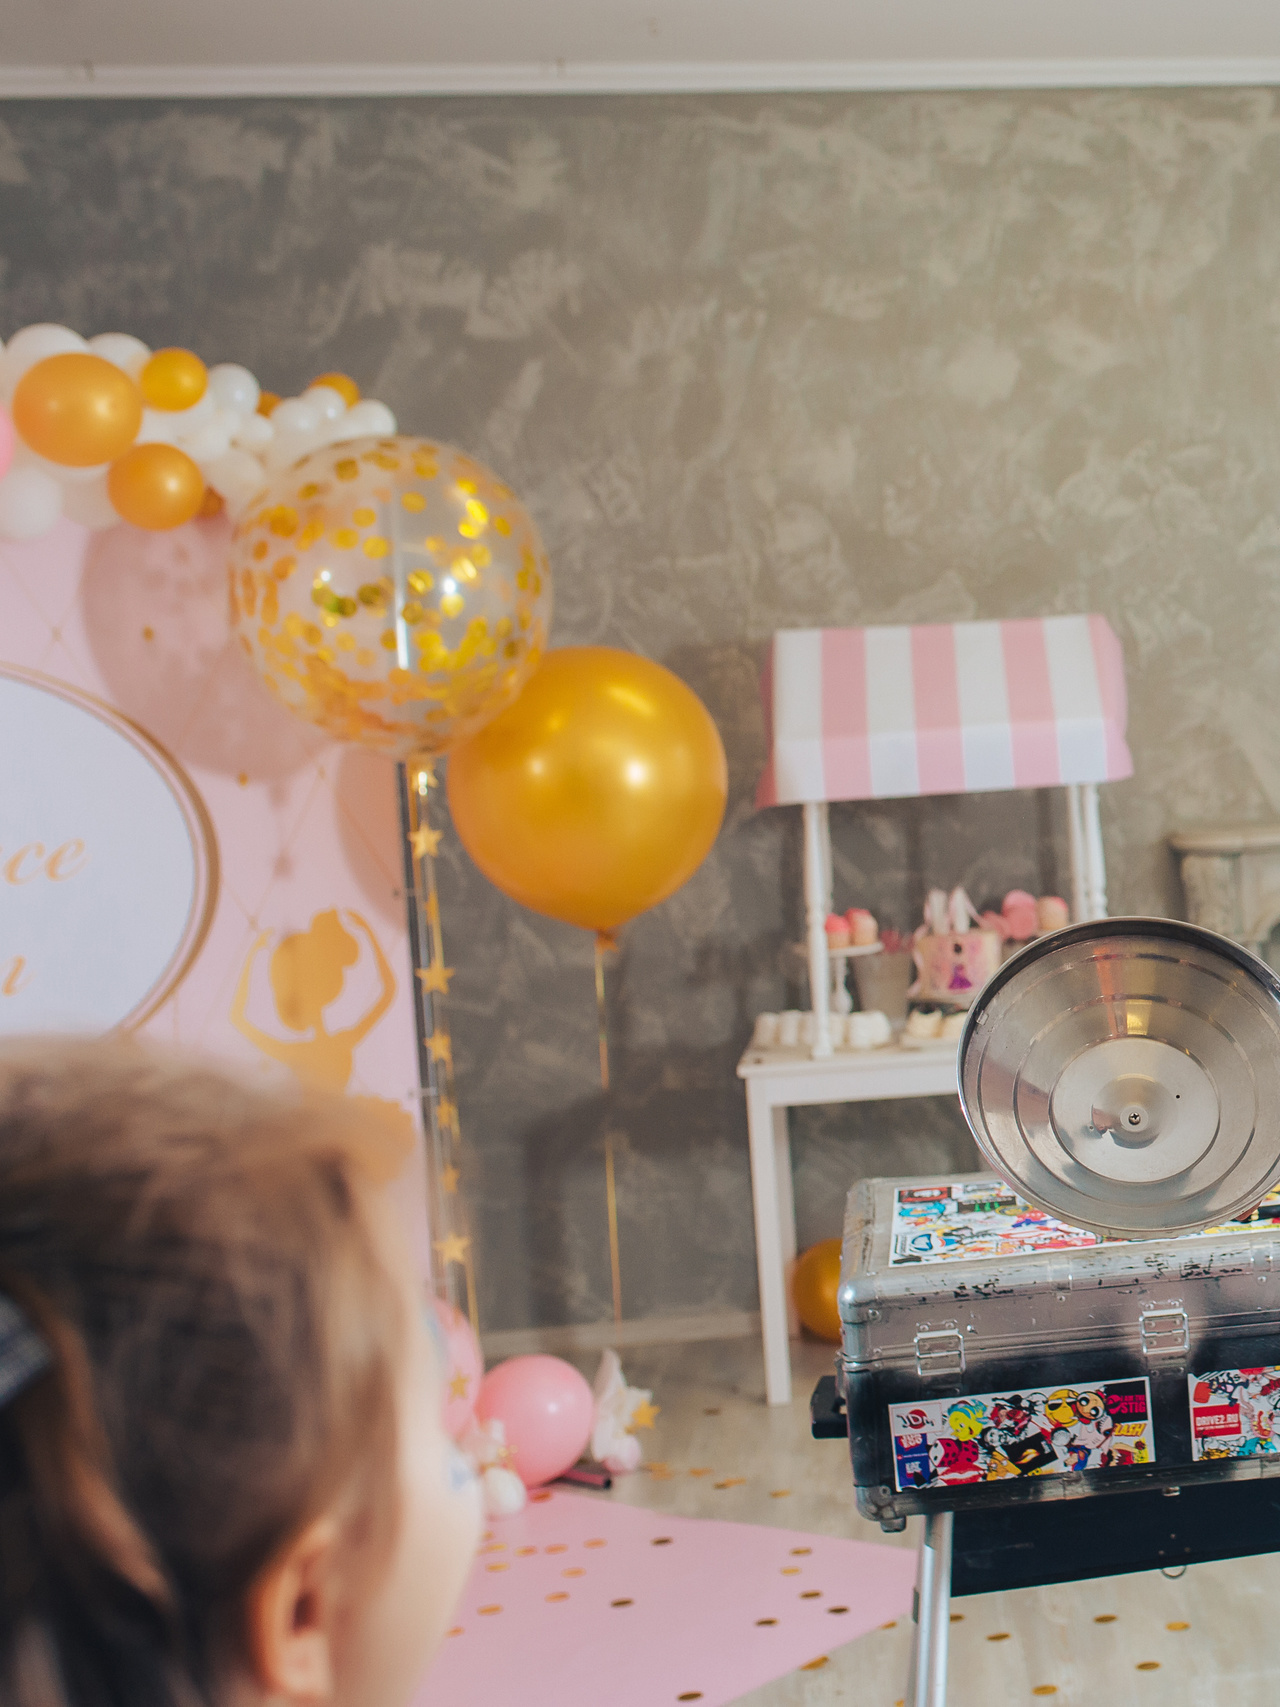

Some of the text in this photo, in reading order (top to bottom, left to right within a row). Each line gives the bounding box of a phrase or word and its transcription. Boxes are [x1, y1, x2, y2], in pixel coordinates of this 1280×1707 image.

[0, 838, 92, 886] ce
[1121, 1402, 1146, 1413] STIG
[1195, 1413, 1239, 1427] DRIVE2.RU
[1114, 1423, 1147, 1437] LASH
